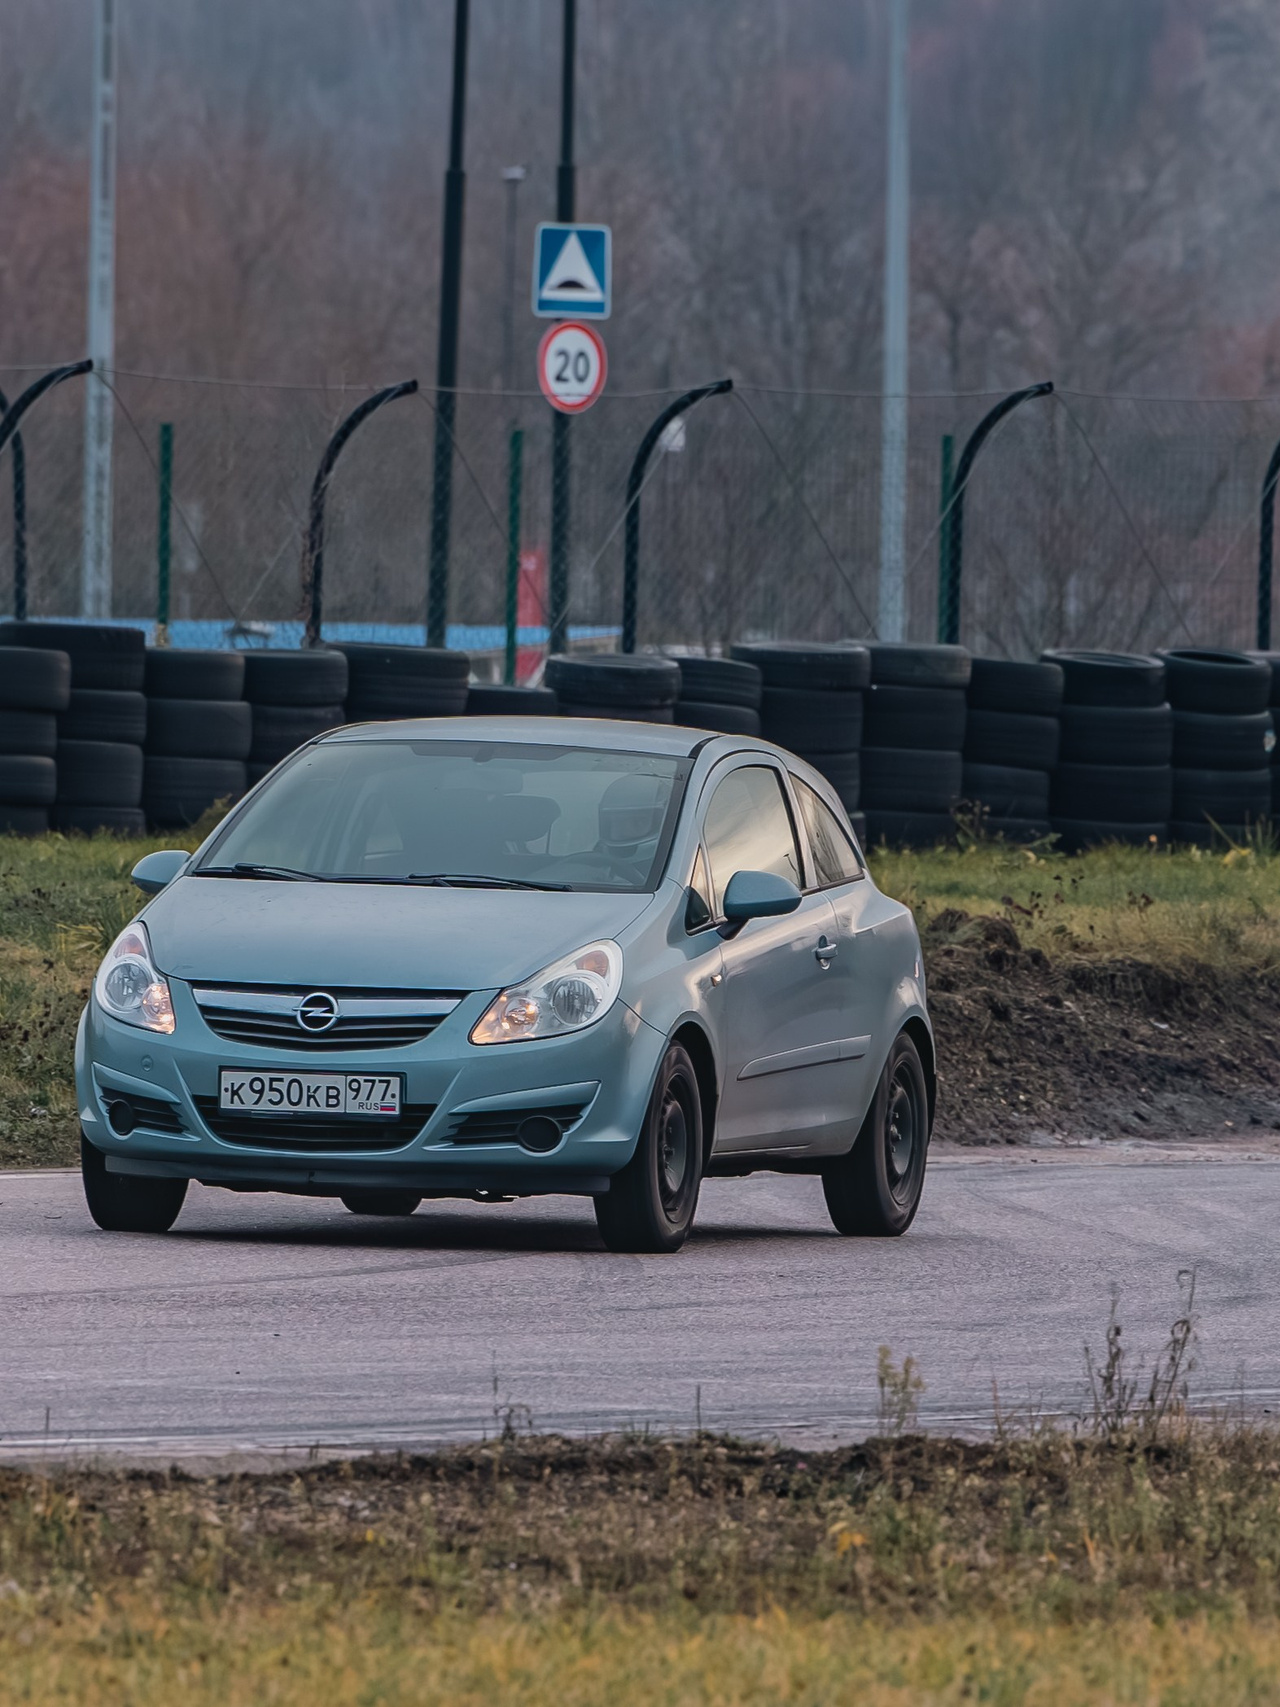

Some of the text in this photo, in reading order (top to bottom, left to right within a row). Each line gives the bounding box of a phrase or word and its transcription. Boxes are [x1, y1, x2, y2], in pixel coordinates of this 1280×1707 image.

[554, 350, 590, 383] 20
[348, 1078, 392, 1101] 977
[358, 1102, 380, 1111] RUS
